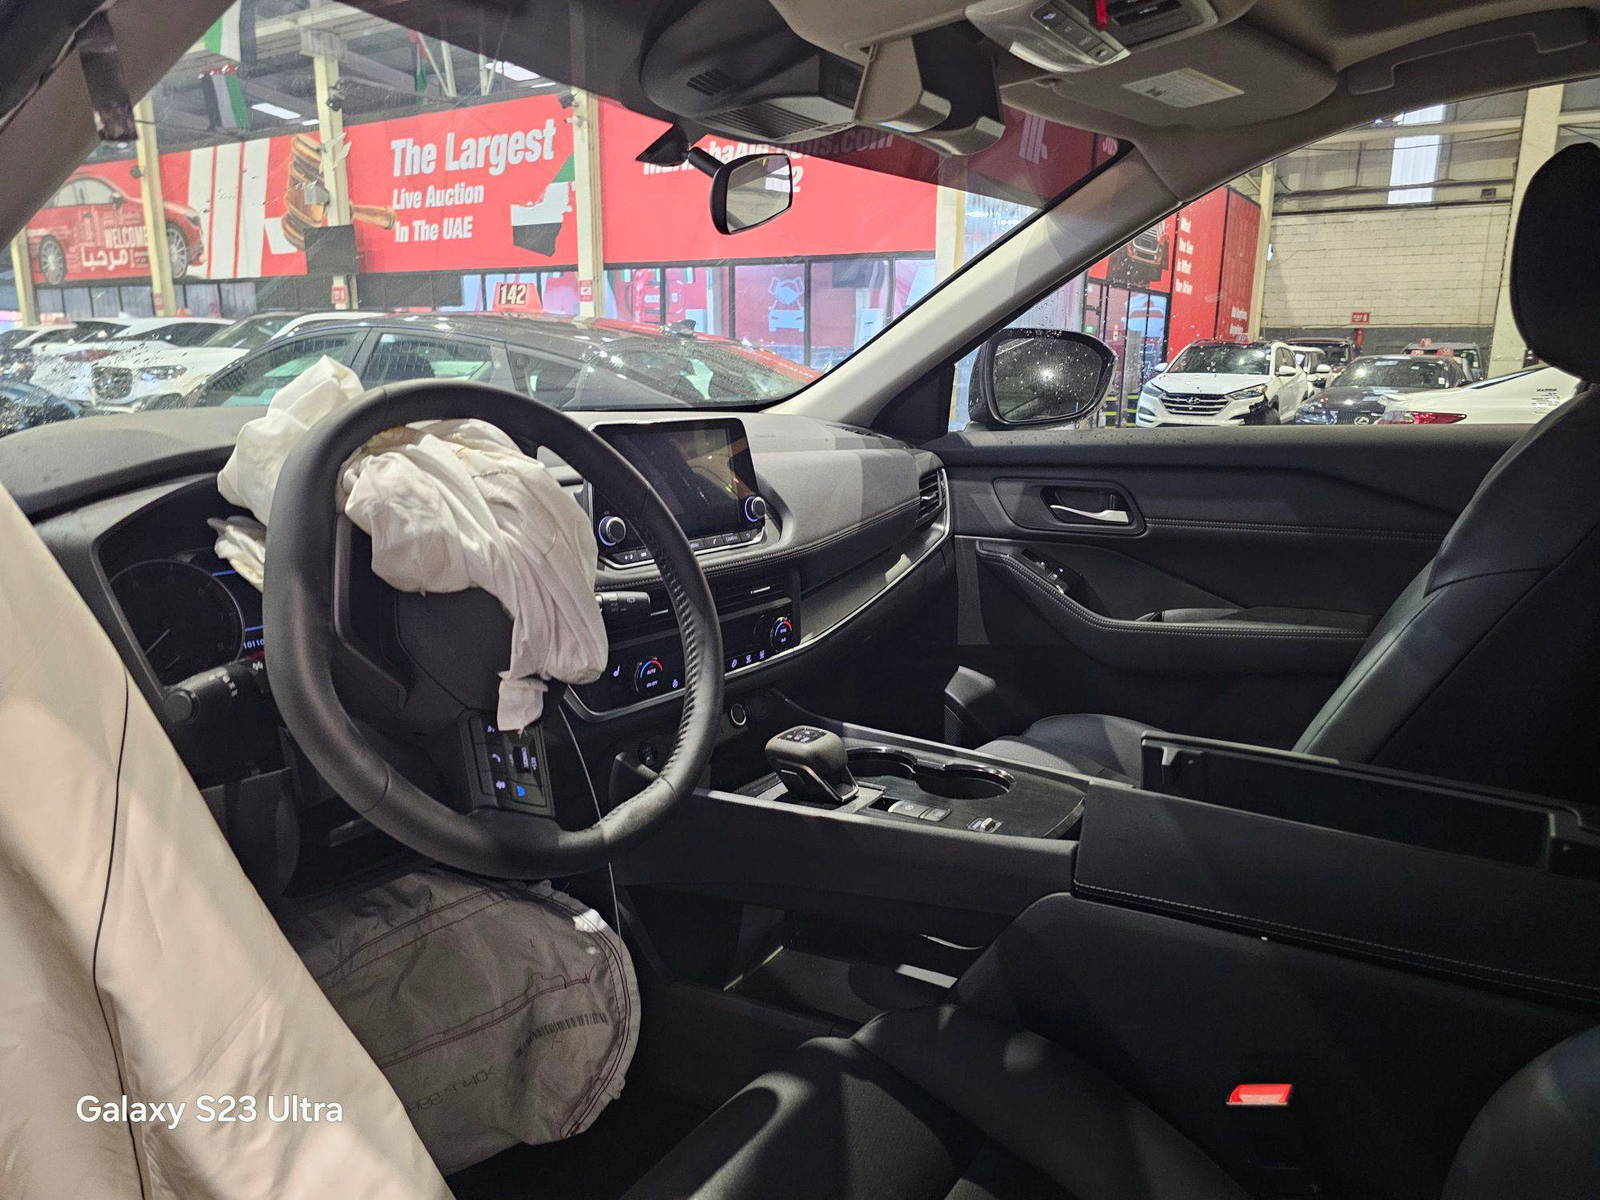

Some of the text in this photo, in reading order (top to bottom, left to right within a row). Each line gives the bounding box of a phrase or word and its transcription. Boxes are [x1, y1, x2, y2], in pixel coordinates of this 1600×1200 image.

[391, 118, 556, 177] The Largest
[392, 183, 485, 210] Live Auction
[395, 216, 474, 242] In The UAE
[500, 284, 527, 305] 142
